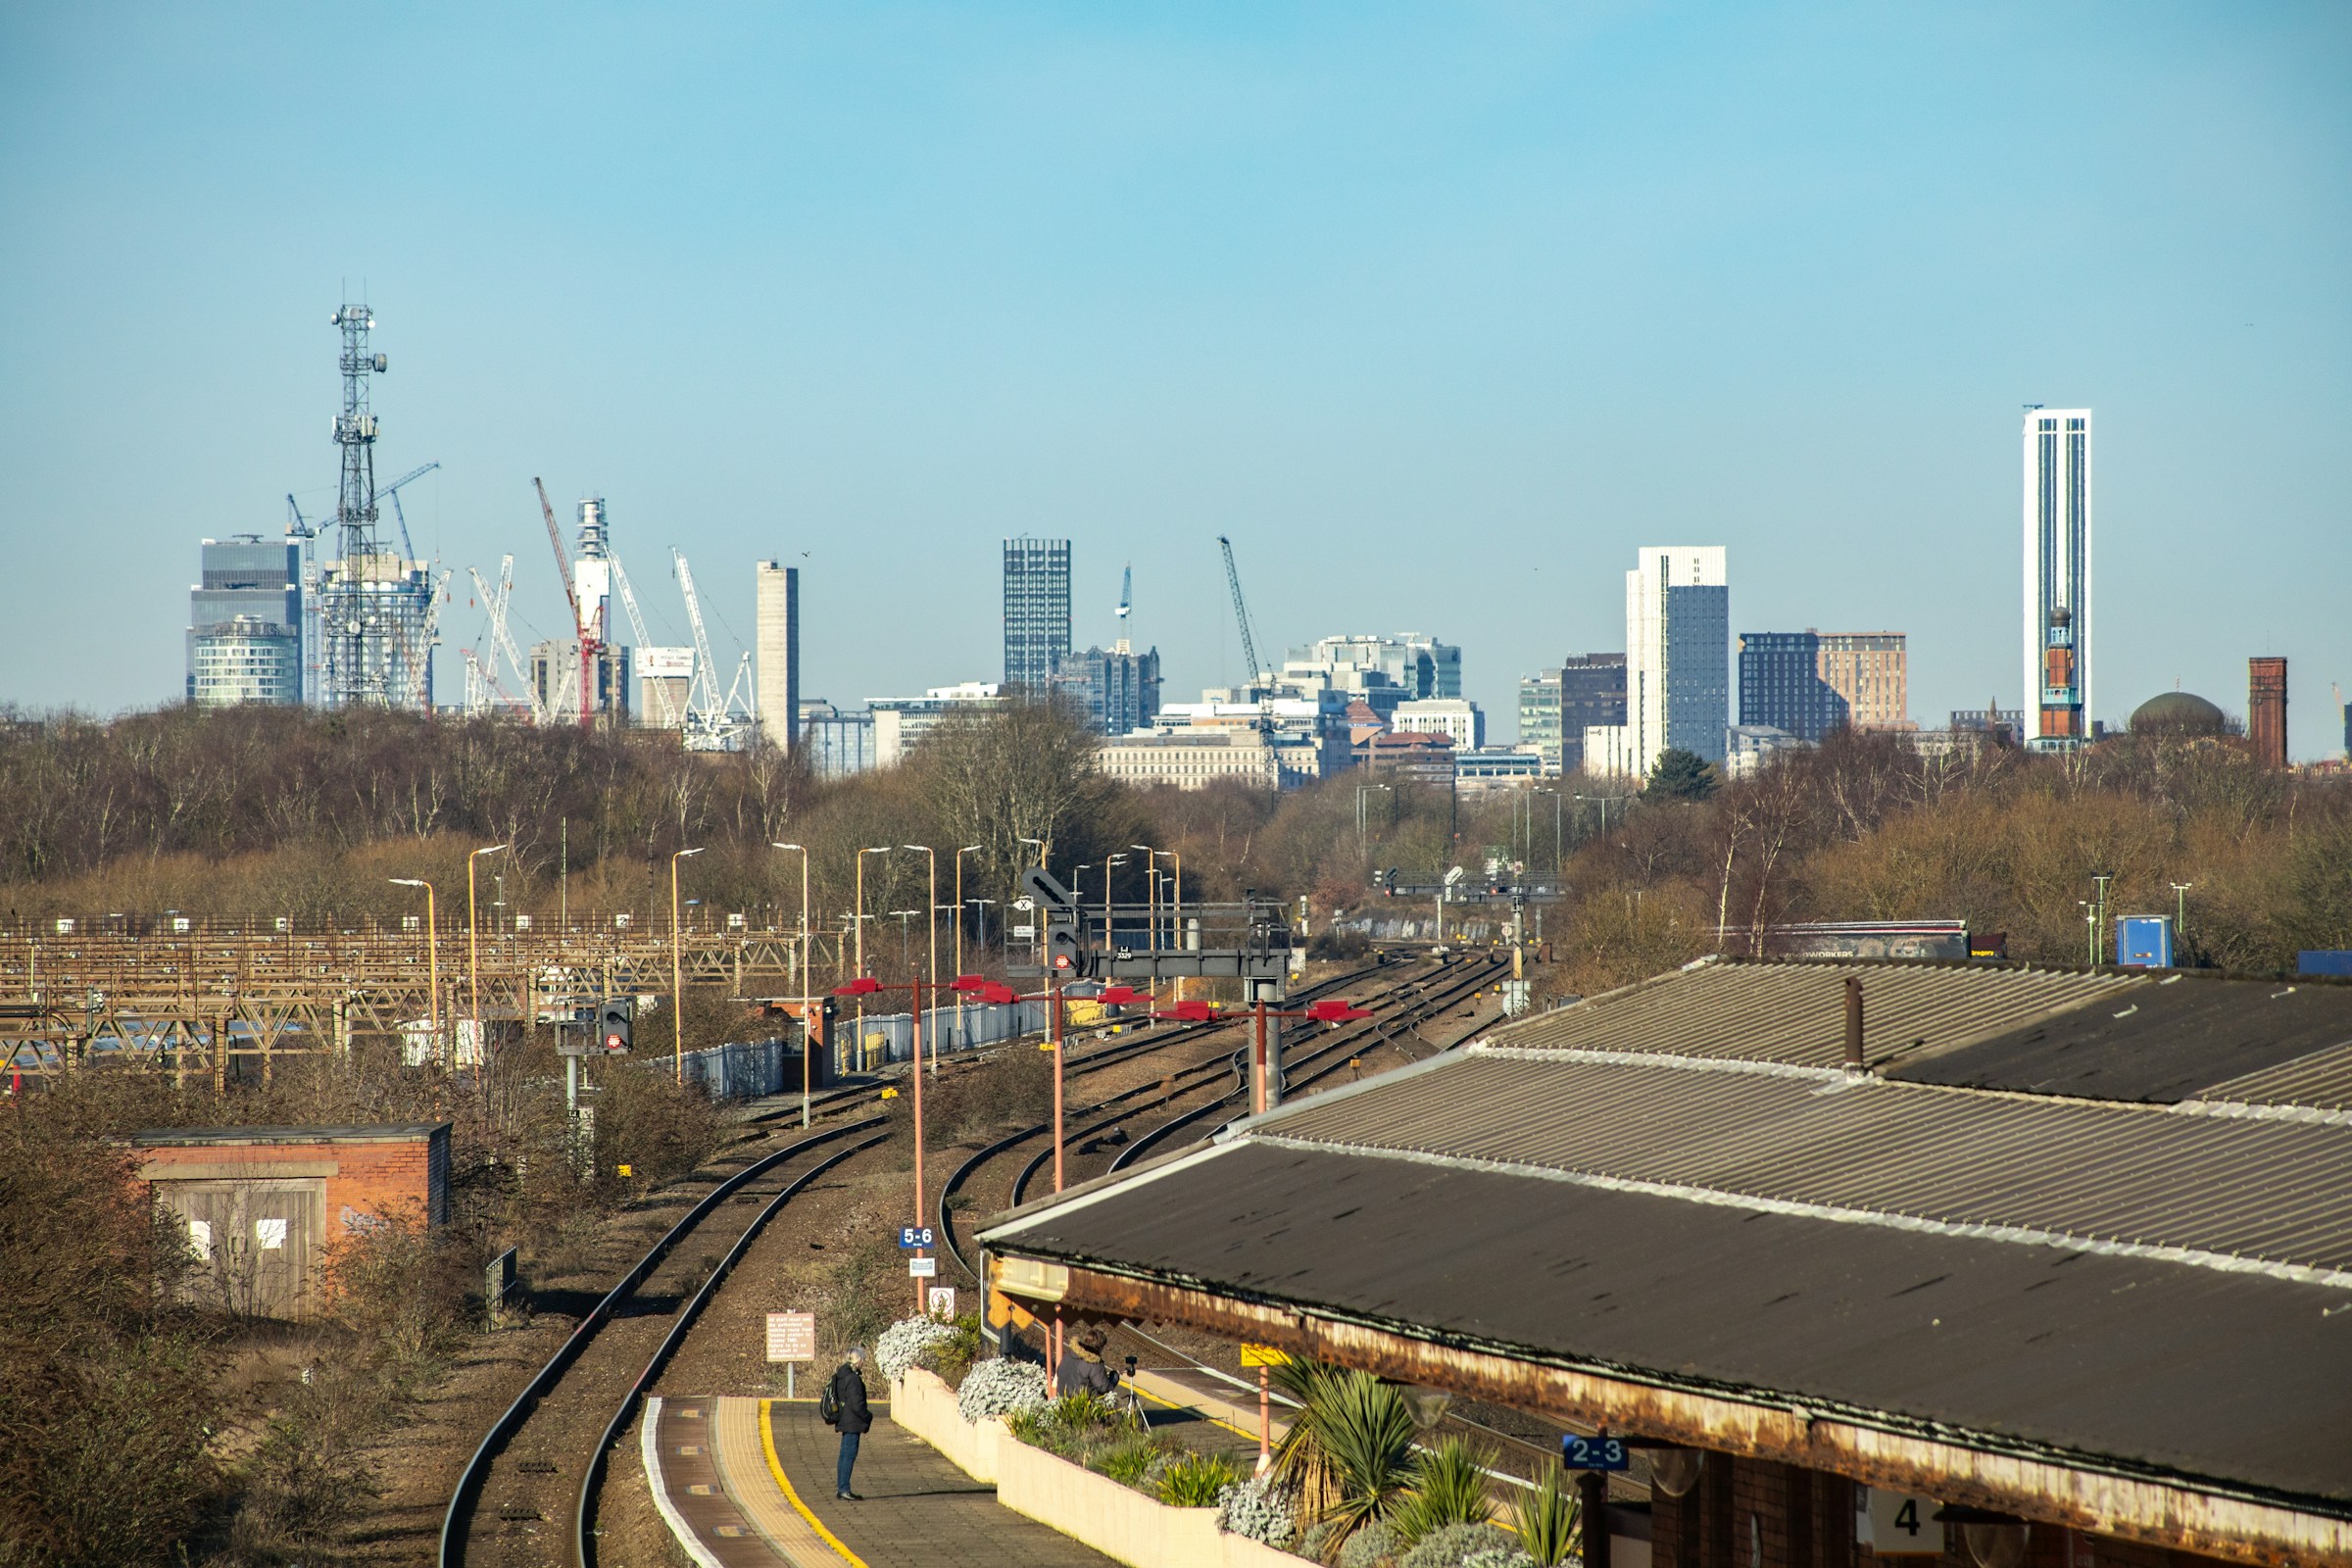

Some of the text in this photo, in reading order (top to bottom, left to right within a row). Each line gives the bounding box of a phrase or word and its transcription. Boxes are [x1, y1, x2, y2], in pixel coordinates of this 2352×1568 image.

[1020, 901, 1027, 909] X
[904, 1228, 932, 1244] 5-6
[1572, 1439, 1623, 1462] 2-3
[1894, 1498, 1921, 1536] 4
